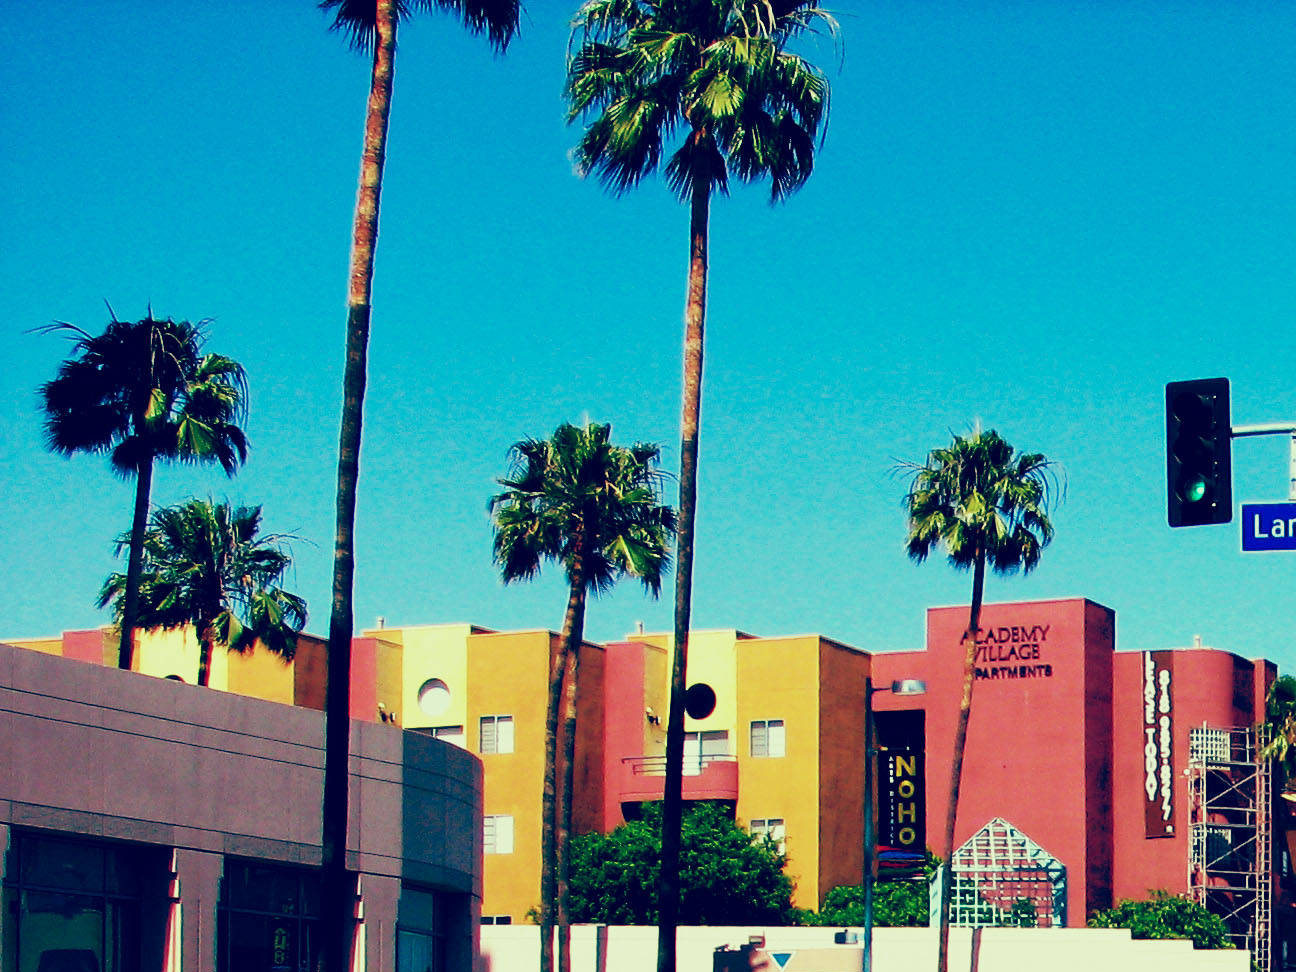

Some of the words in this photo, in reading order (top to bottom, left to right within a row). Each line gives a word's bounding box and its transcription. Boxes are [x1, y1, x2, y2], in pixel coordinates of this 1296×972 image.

[974, 664, 1053, 680] PARTMENTS
[1145, 651, 1156, 724] LEASE
[896, 755, 916, 845] NOHO
[1145, 728, 1157, 801] TODAY
